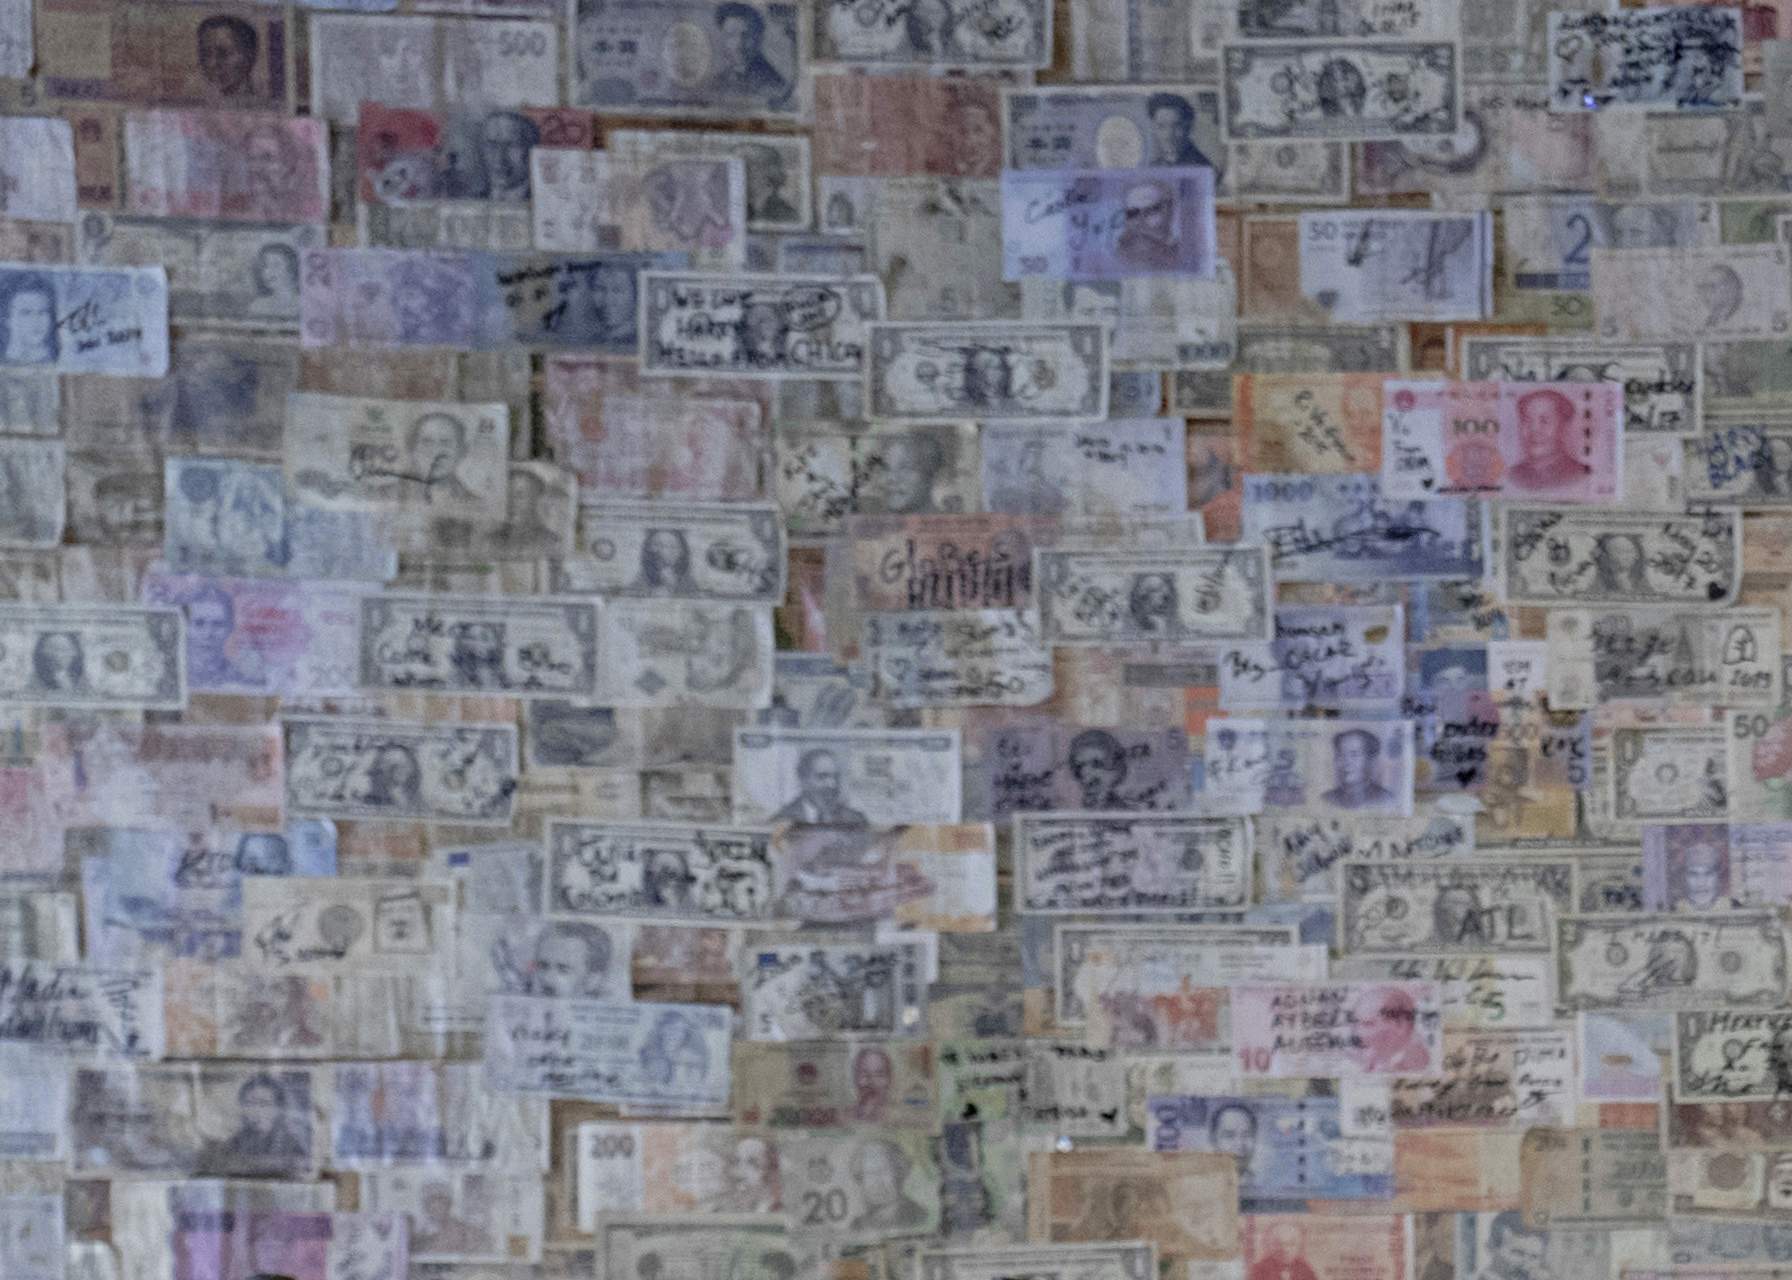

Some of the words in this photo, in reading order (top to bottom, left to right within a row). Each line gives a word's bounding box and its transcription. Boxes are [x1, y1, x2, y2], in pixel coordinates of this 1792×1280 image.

[1565, 214, 1593, 265] 2
[1452, 418, 1499, 437] 100
[1733, 715, 1769, 739] 50
[803, 1191, 848, 1225] 20
